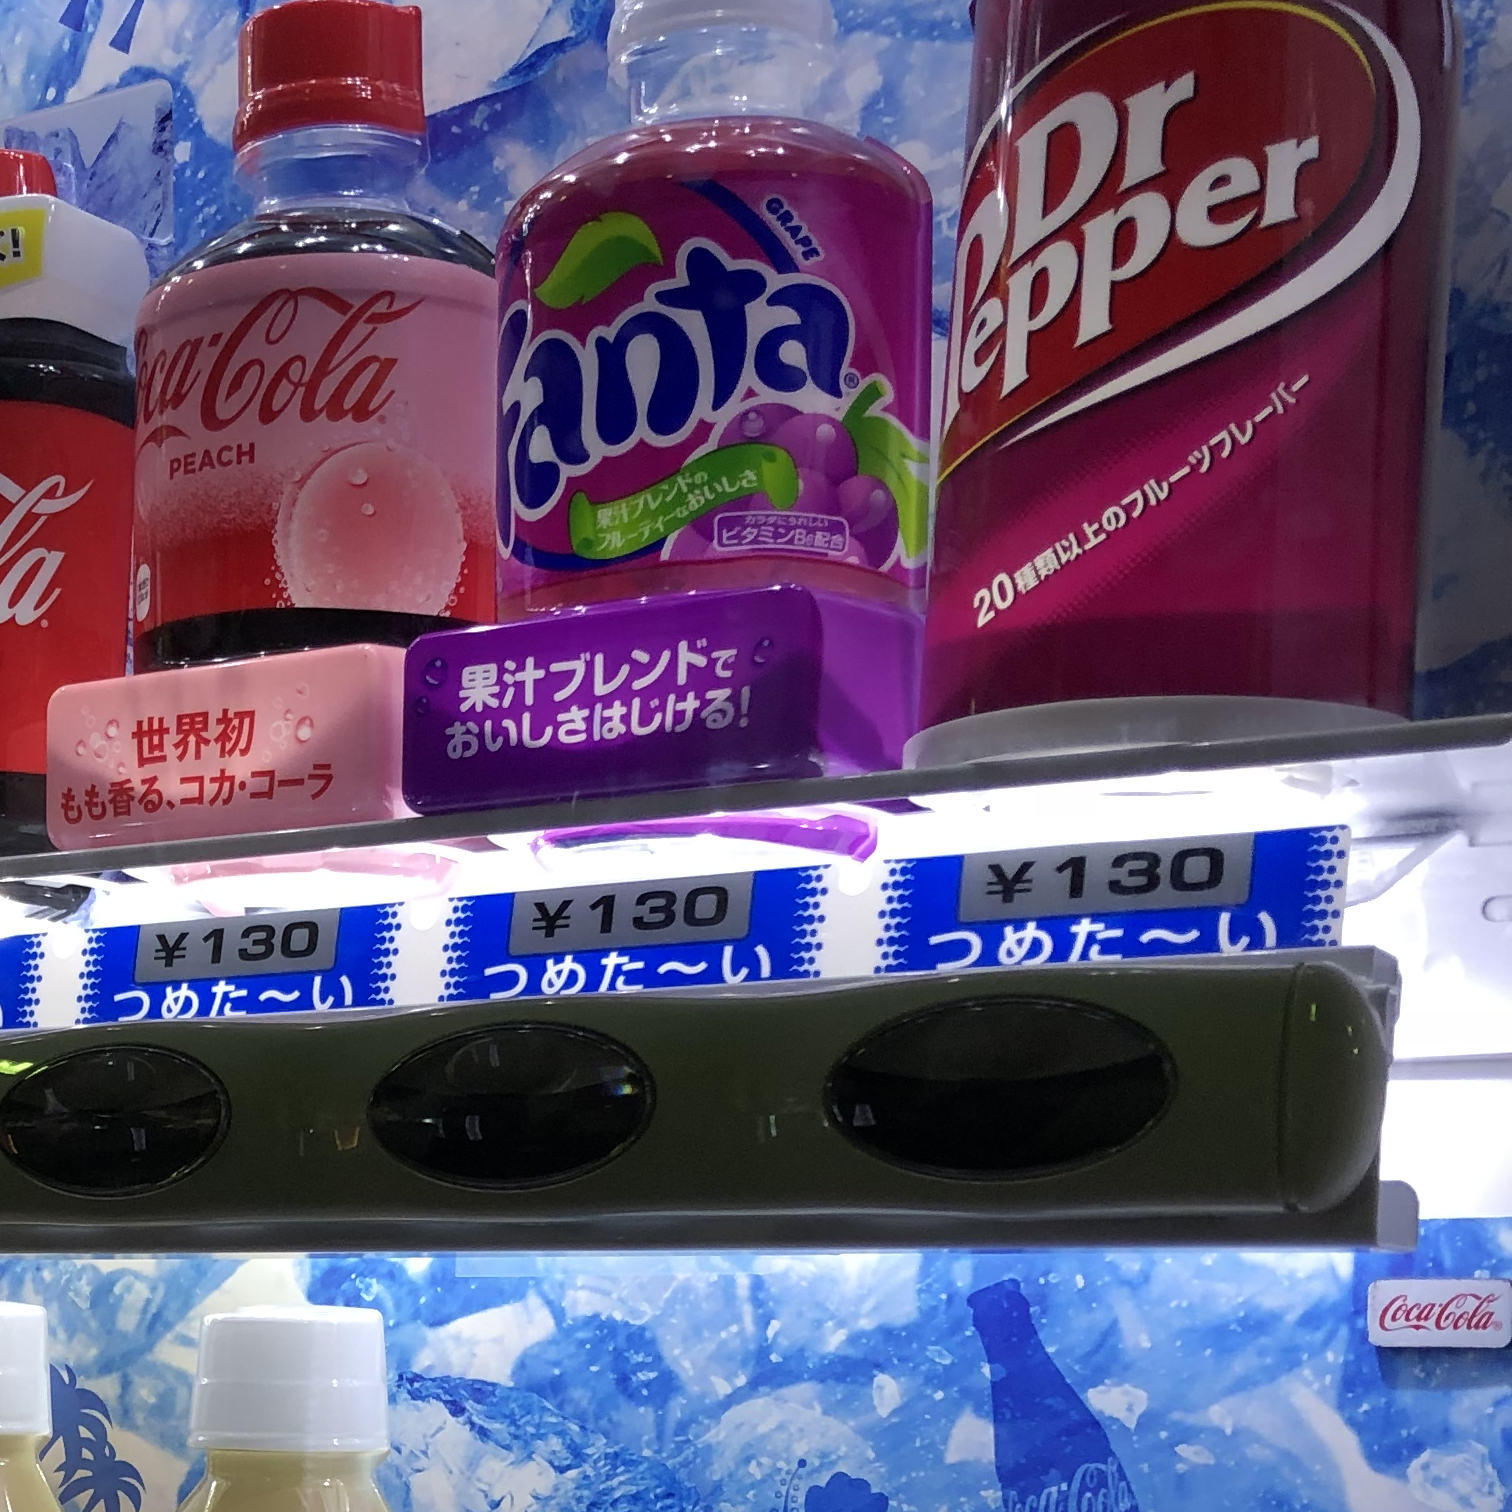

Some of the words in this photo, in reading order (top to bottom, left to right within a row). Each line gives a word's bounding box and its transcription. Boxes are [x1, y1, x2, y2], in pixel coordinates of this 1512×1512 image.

[1009, 70, 1196, 268] Dr
[765, 197, 824, 262] GRAPE
[169, 442, 256, 480] PEACH
[972, 374, 1311, 629] 20種類以上のフルーツフレーバー
[459, 638, 738, 713] 果汁ブレンドで
[131, 707, 255, 769] 世界初
[445, 687, 752, 760] おいしさはじける!
[59, 763, 334, 825] もも香る、コカ・コーラ
[985, 846, 1225, 905] ¥130
[532, 885, 730, 939] ¥130
[153, 919, 320, 970] ¥130
[1378, 1291, 1501, 1333] Coca-Cola
